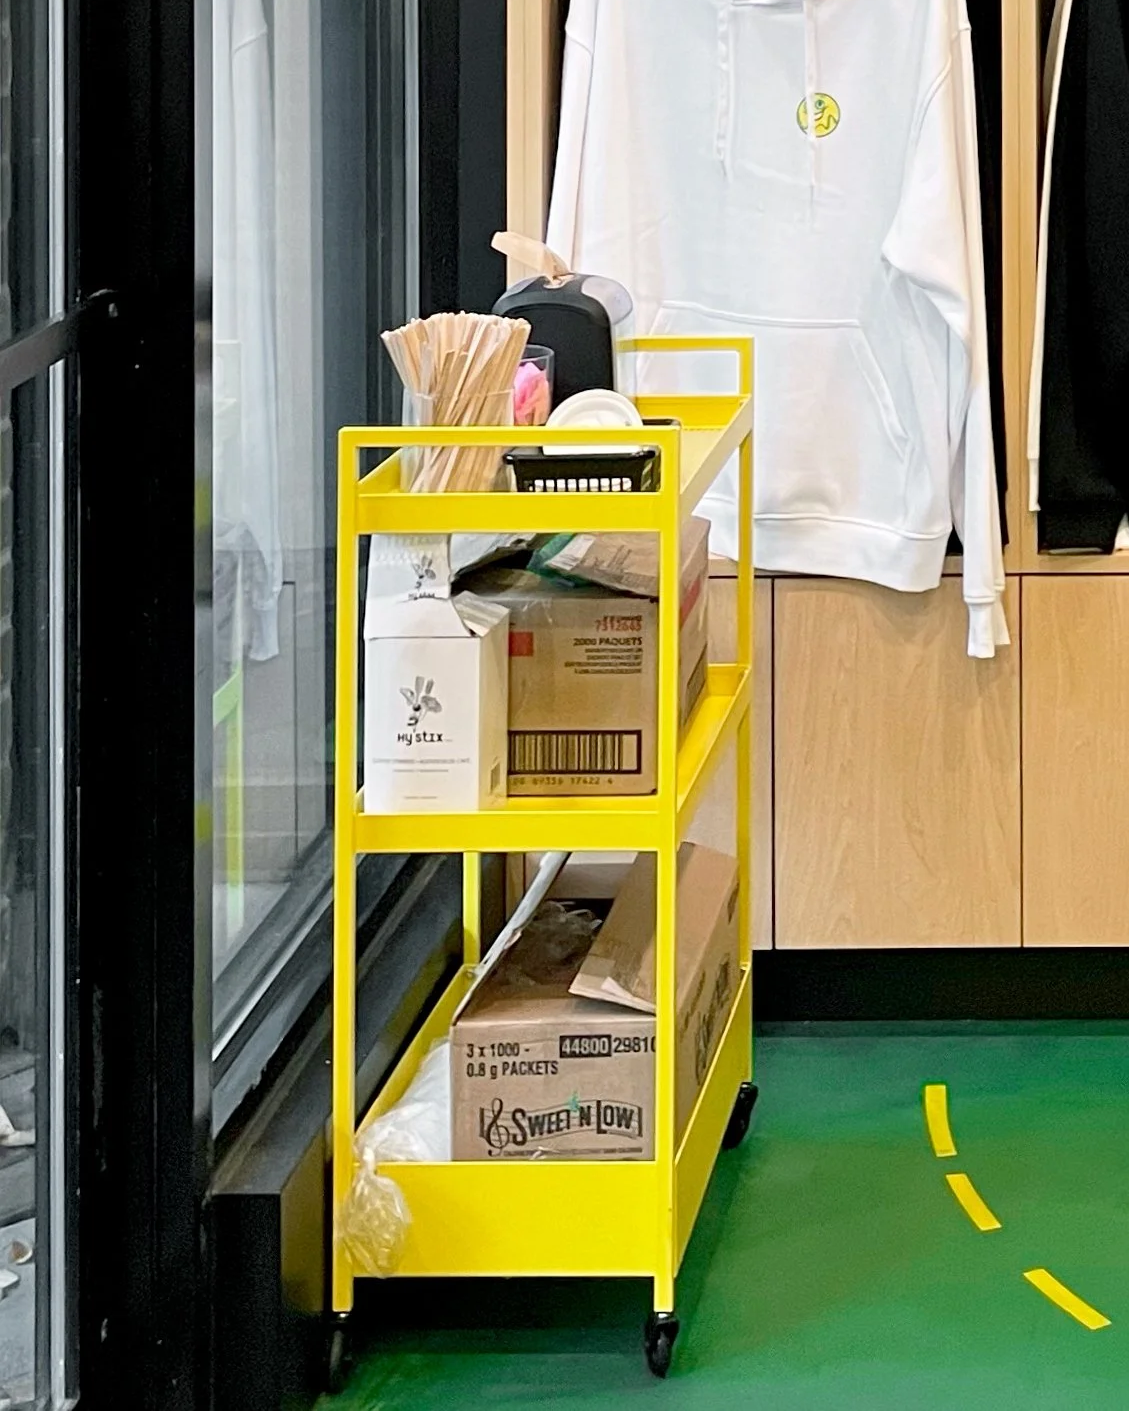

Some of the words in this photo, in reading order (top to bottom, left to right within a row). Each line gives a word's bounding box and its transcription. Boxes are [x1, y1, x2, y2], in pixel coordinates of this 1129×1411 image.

[598, 636, 643, 646] PAQUETS
[466, 1043, 474, 1058] 3
[478, 1047, 486, 1058] x
[491, 1042, 520, 1058] 1000
[561, 1037, 609, 1055] 44800
[466, 1062, 486, 1077] 0.8
[489, 1064, 498, 1080] g
[502, 1060, 559, 1077] PACKETS
[596, 1099, 636, 1135] LOW
